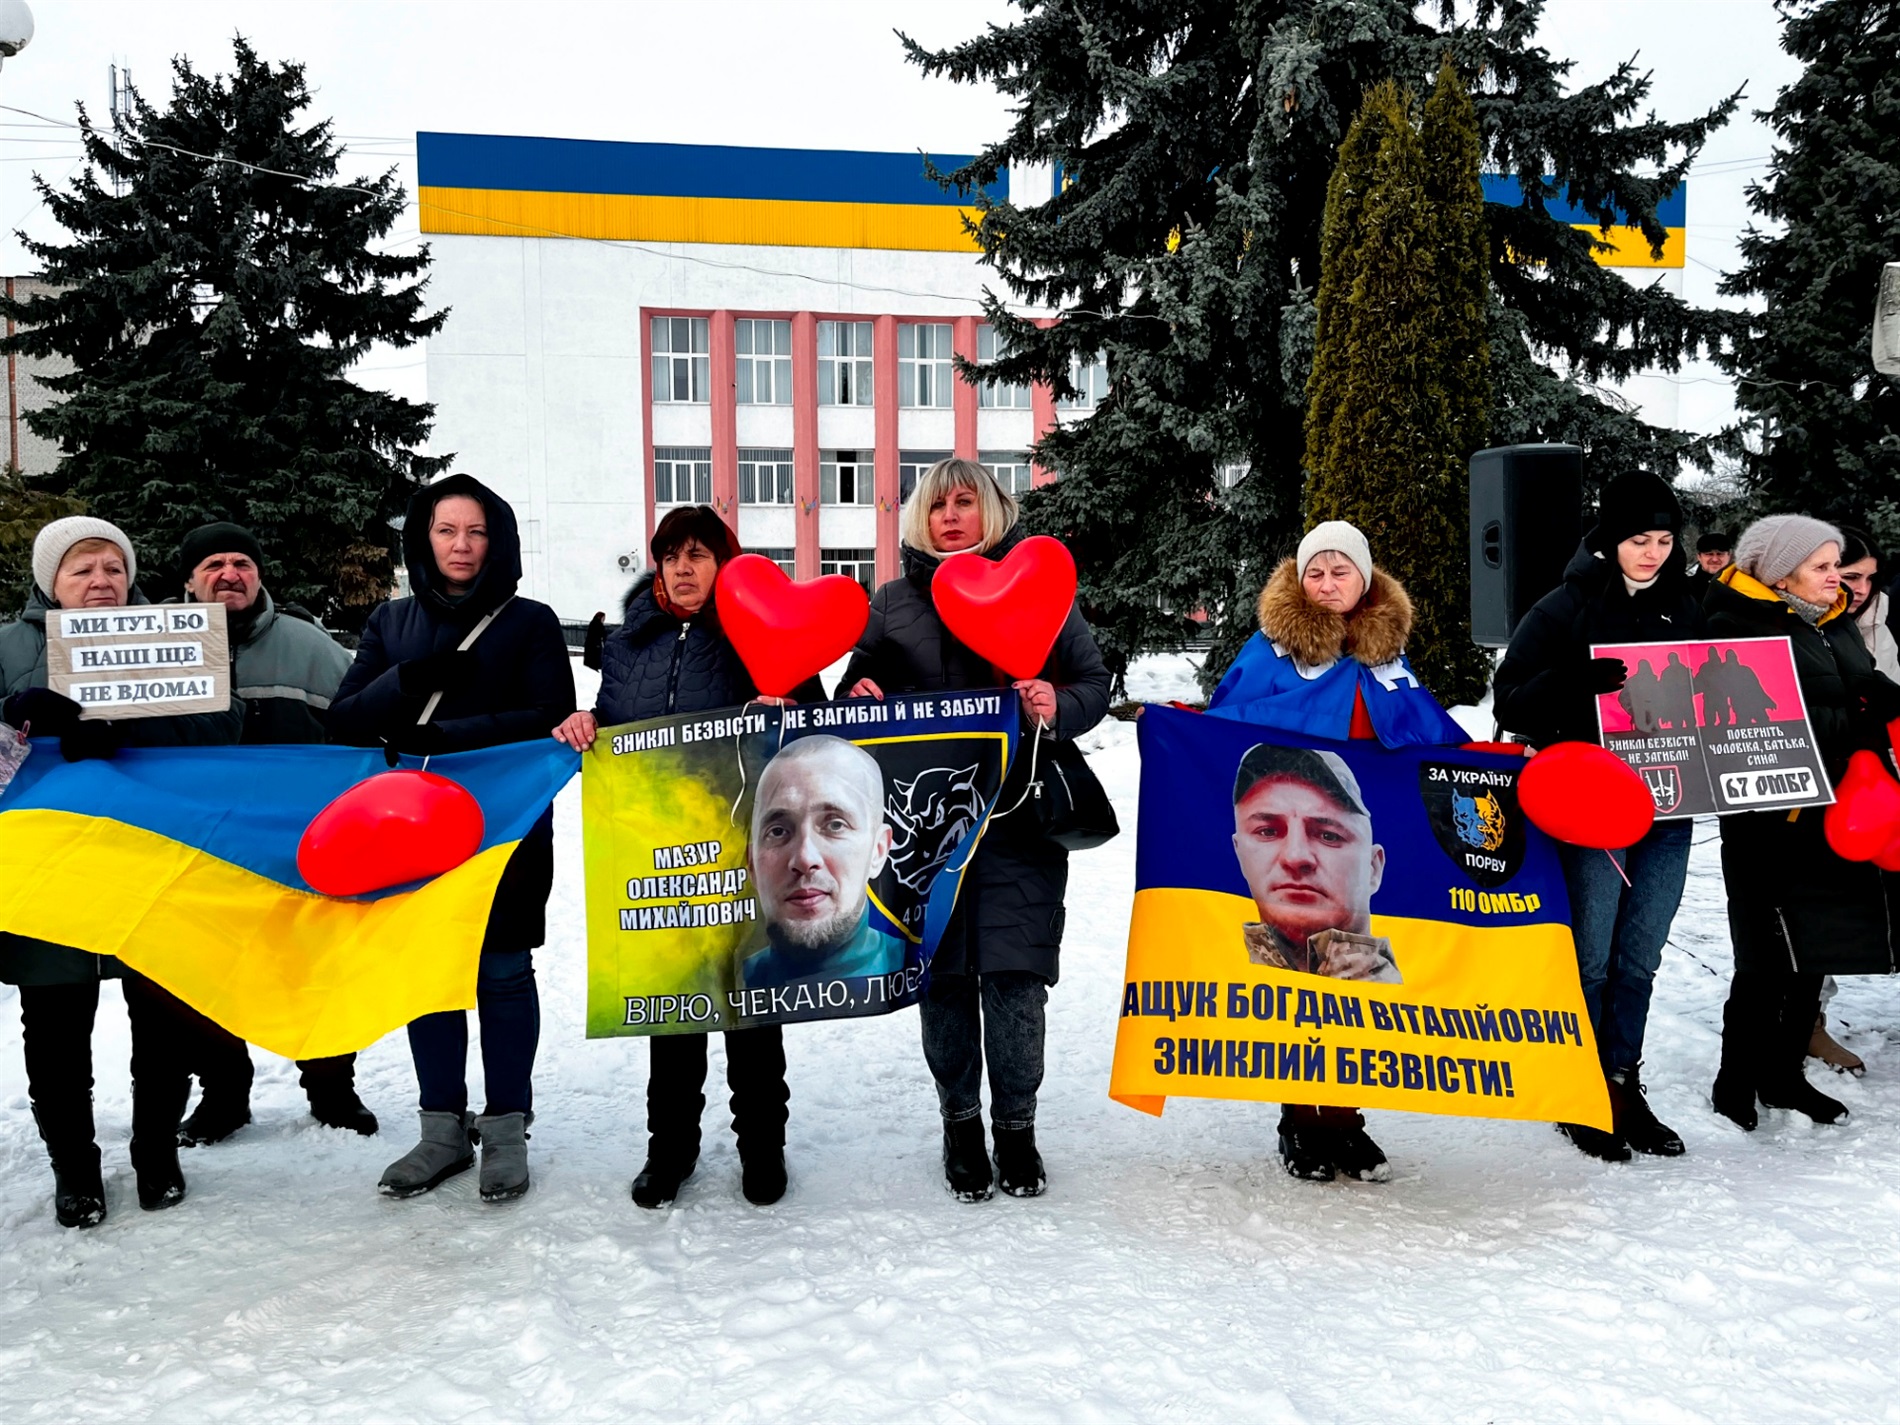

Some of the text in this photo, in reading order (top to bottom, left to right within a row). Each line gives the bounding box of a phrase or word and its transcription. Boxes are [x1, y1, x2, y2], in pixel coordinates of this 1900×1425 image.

[70, 614, 204, 634] МИ ТУТ, БО
[81, 647, 196, 667] НАШІ ЩЕ
[79, 681, 207, 702] НЕ ВДОМА!
[612, 726, 676, 755] ЗНИКЛІ
[682, 714, 765, 743] БЕЗВІСТИ
[785, 710, 807, 730] НЕ
[813, 705, 888, 727] ЗАГИБЛІ
[894, 701, 907, 721] Й
[913, 701, 935, 719] НЕ
[1727, 726, 1784, 740] ПОВЕРНІТЬ
[1609, 736, 1696, 751] ЗНИКЛІ БЕЗВІСТИ
[1709, 738, 1810, 755] ЧОЛОВІКА, БАТЬКА,
[1628, 753, 1642, 764] НЕ
[1644, 750, 1690, 763] ЗАГИБЛІ!
[1747, 753, 1779, 766] СИНА!
[1428, 768, 1512, 787] ЗА УКРАЇНУ
[1725, 772, 1811, 798] 67 ОМБР
[654, 841, 721, 869] МАЗУР
[1465, 853, 1506, 872] ПОРВУ
[627, 868, 747, 900] ОЛЕКСАНДР
[1448, 887, 1541, 914] 110 ОМБр
[619, 898, 757, 930] МИХАЙЛОВИЧ
[625, 994, 721, 1024] ВІРЮ,
[728, 980, 855, 1017] ЧЕКАЮ,
[1227, 982, 1365, 1029] БОГДАН
[1368, 1000, 1583, 1047] ВІТАЛІЙОВИЧ
[1154, 1036, 1515, 1098] ЗНИКЛИЙ БЕЗВІСТИ!
